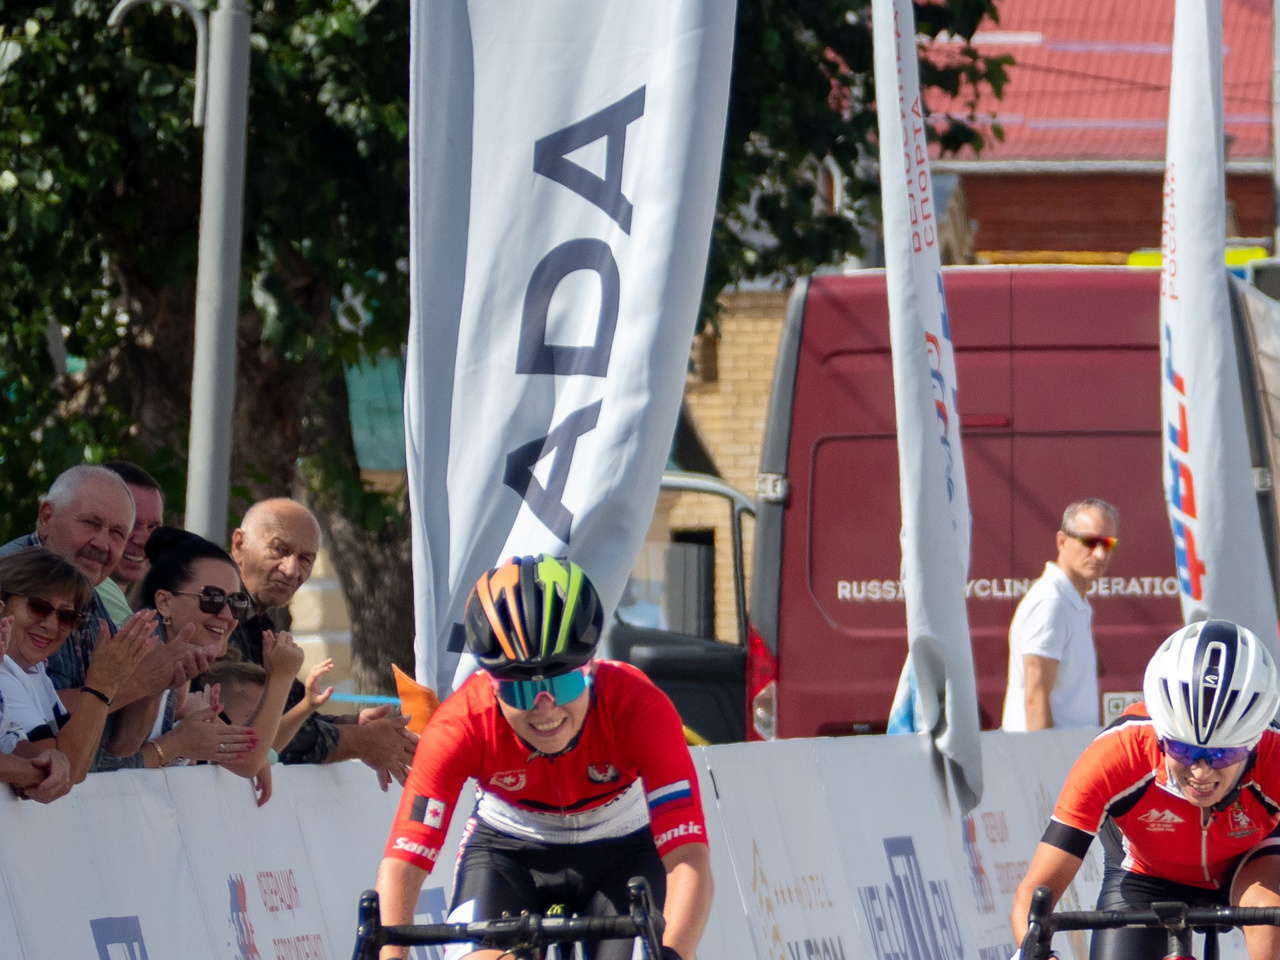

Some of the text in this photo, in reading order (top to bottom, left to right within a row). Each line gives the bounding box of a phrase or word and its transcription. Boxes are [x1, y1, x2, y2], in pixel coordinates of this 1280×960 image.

[450, 84, 646, 653] ADA
[837, 576, 1180, 600] RUSSI YCLIN DERATIO
[392, 837, 439, 862] Sant
